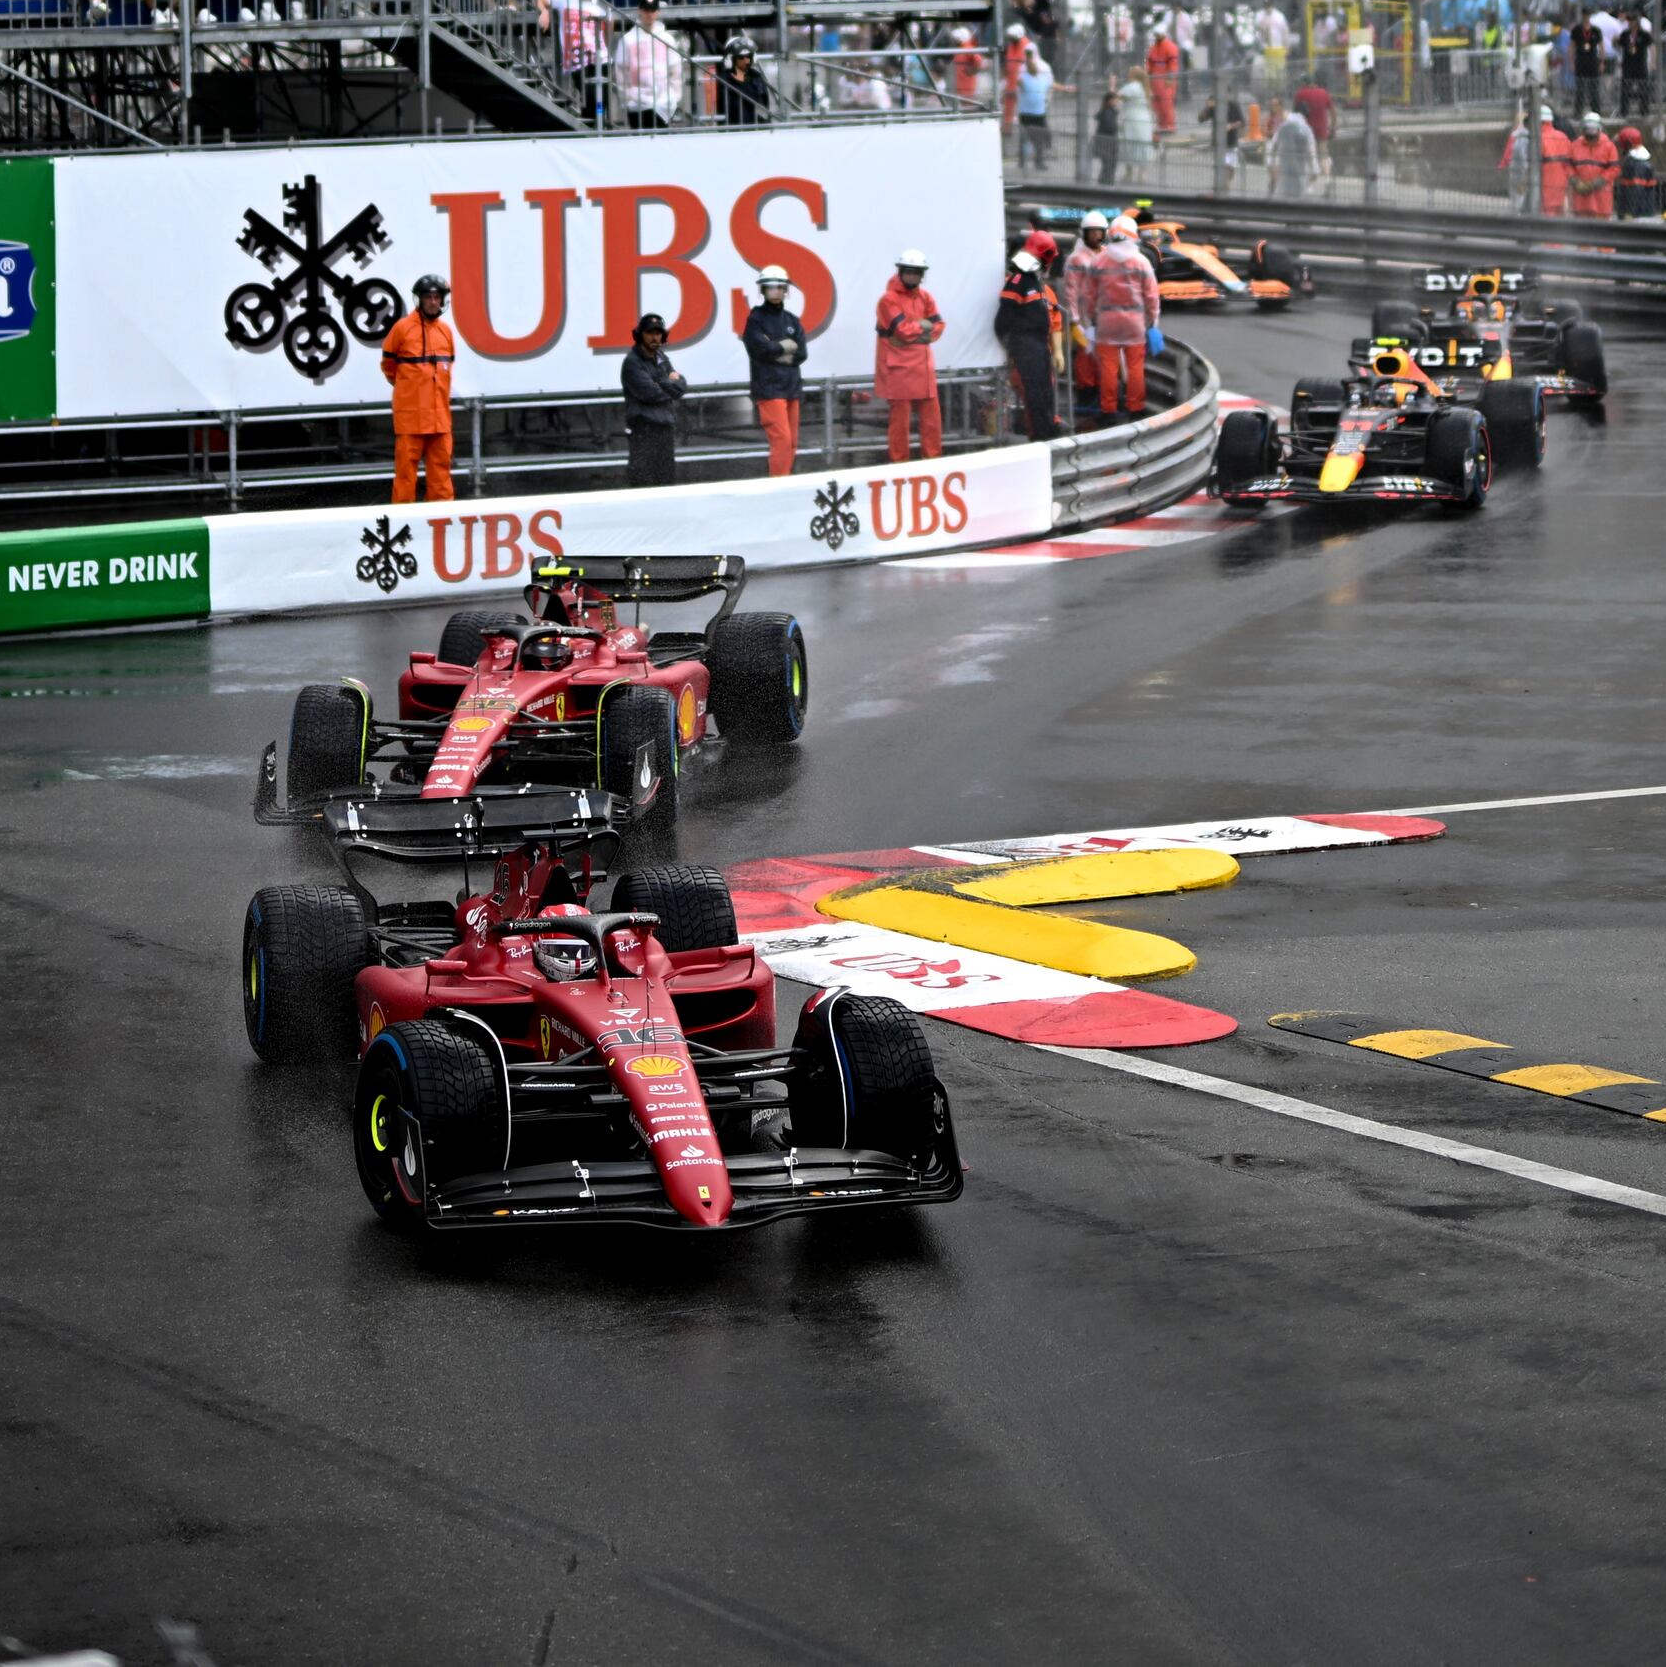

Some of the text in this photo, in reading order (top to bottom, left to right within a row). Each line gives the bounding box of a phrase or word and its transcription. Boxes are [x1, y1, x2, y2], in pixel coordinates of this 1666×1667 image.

[430, 176, 835, 360] UBS
[868, 471, 968, 541] UBS
[428, 509, 565, 583] UBS
[8, 560, 99, 593] NEVER
[108, 552, 198, 585] DRINK
[830, 953, 1002, 989] UBS
[600, 1017, 666, 1025] VELAS
[596, 1026, 687, 1053] 16
[648, 1083, 685, 1092] aws
[653, 1128, 711, 1143] MAHLE
[665, 1157, 723, 1170] Santander
